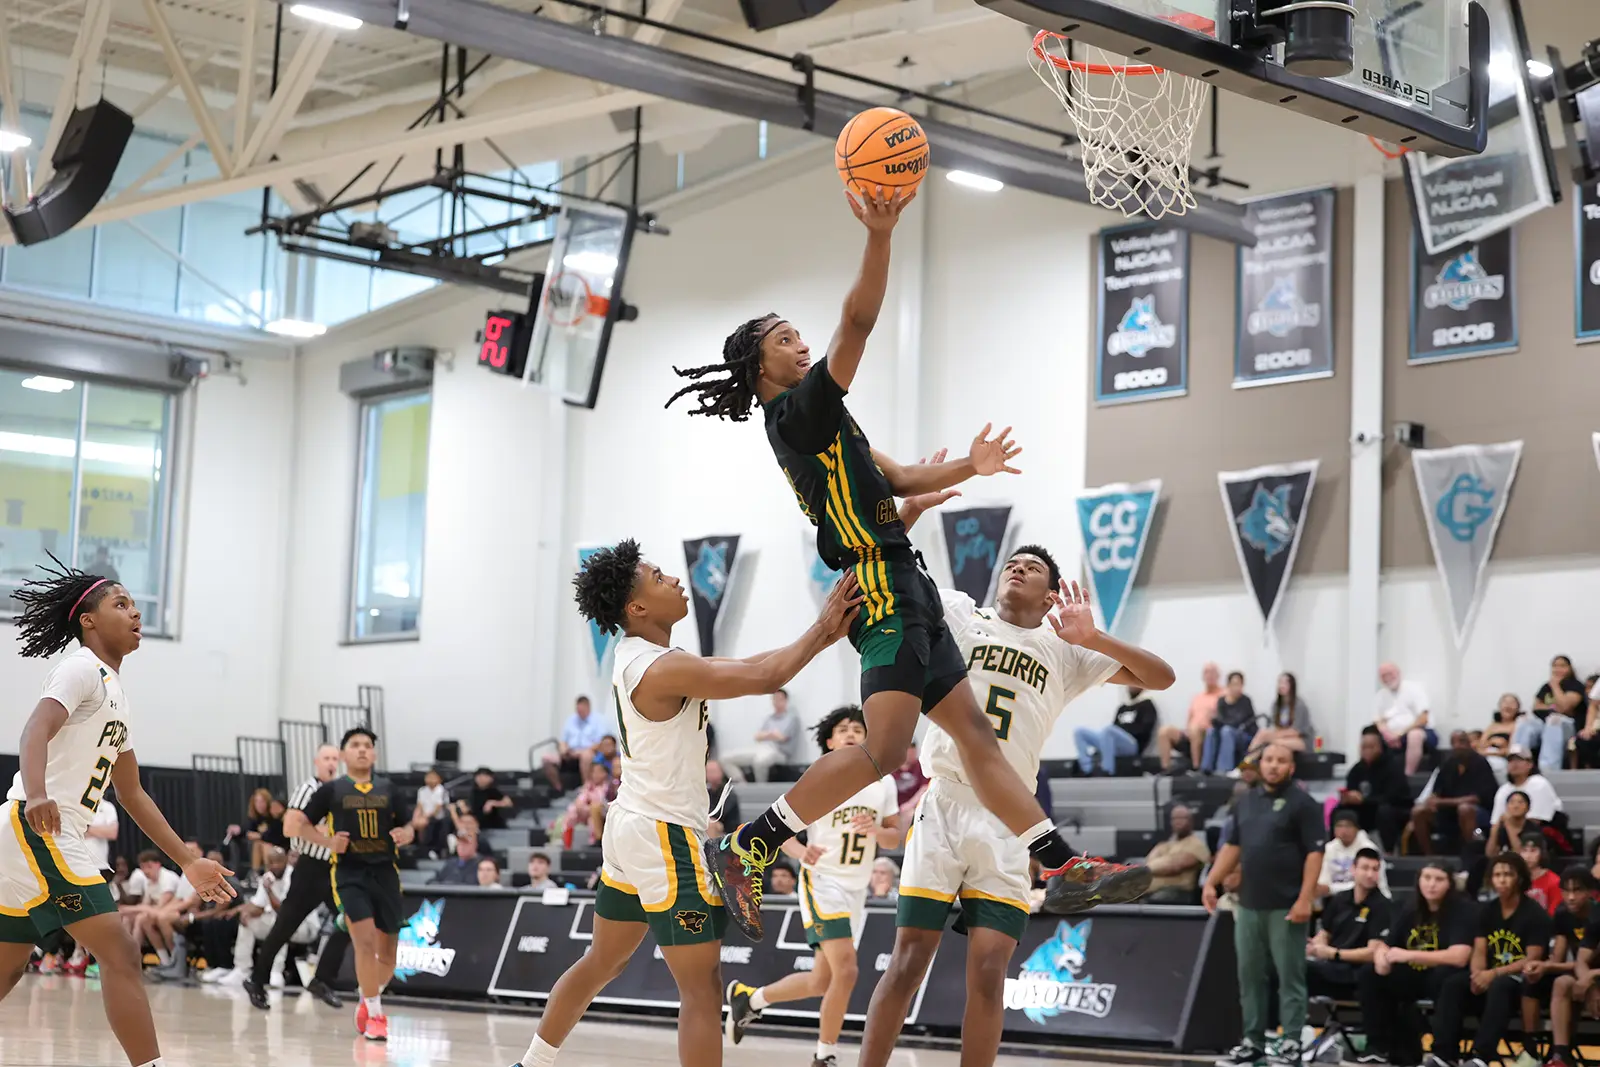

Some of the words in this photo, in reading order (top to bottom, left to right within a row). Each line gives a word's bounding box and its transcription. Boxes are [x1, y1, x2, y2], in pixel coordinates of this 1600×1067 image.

[883, 125, 920, 148] NCAA
[1426, 171, 1503, 198] Volleyball
[1431, 192, 1499, 217] NJCAA
[1111, 230, 1177, 254] Volleyball
[1114, 249, 1172, 271] NJCAA
[1105, 267, 1183, 291] Tournament
[480, 316, 511, 368] 29
[1113, 367, 1168, 391] 2000
[968, 645, 1049, 695] PEORIA
[985, 684, 1016, 741] 5
[840, 832, 868, 865] 15
[517, 935, 550, 953] HOME
